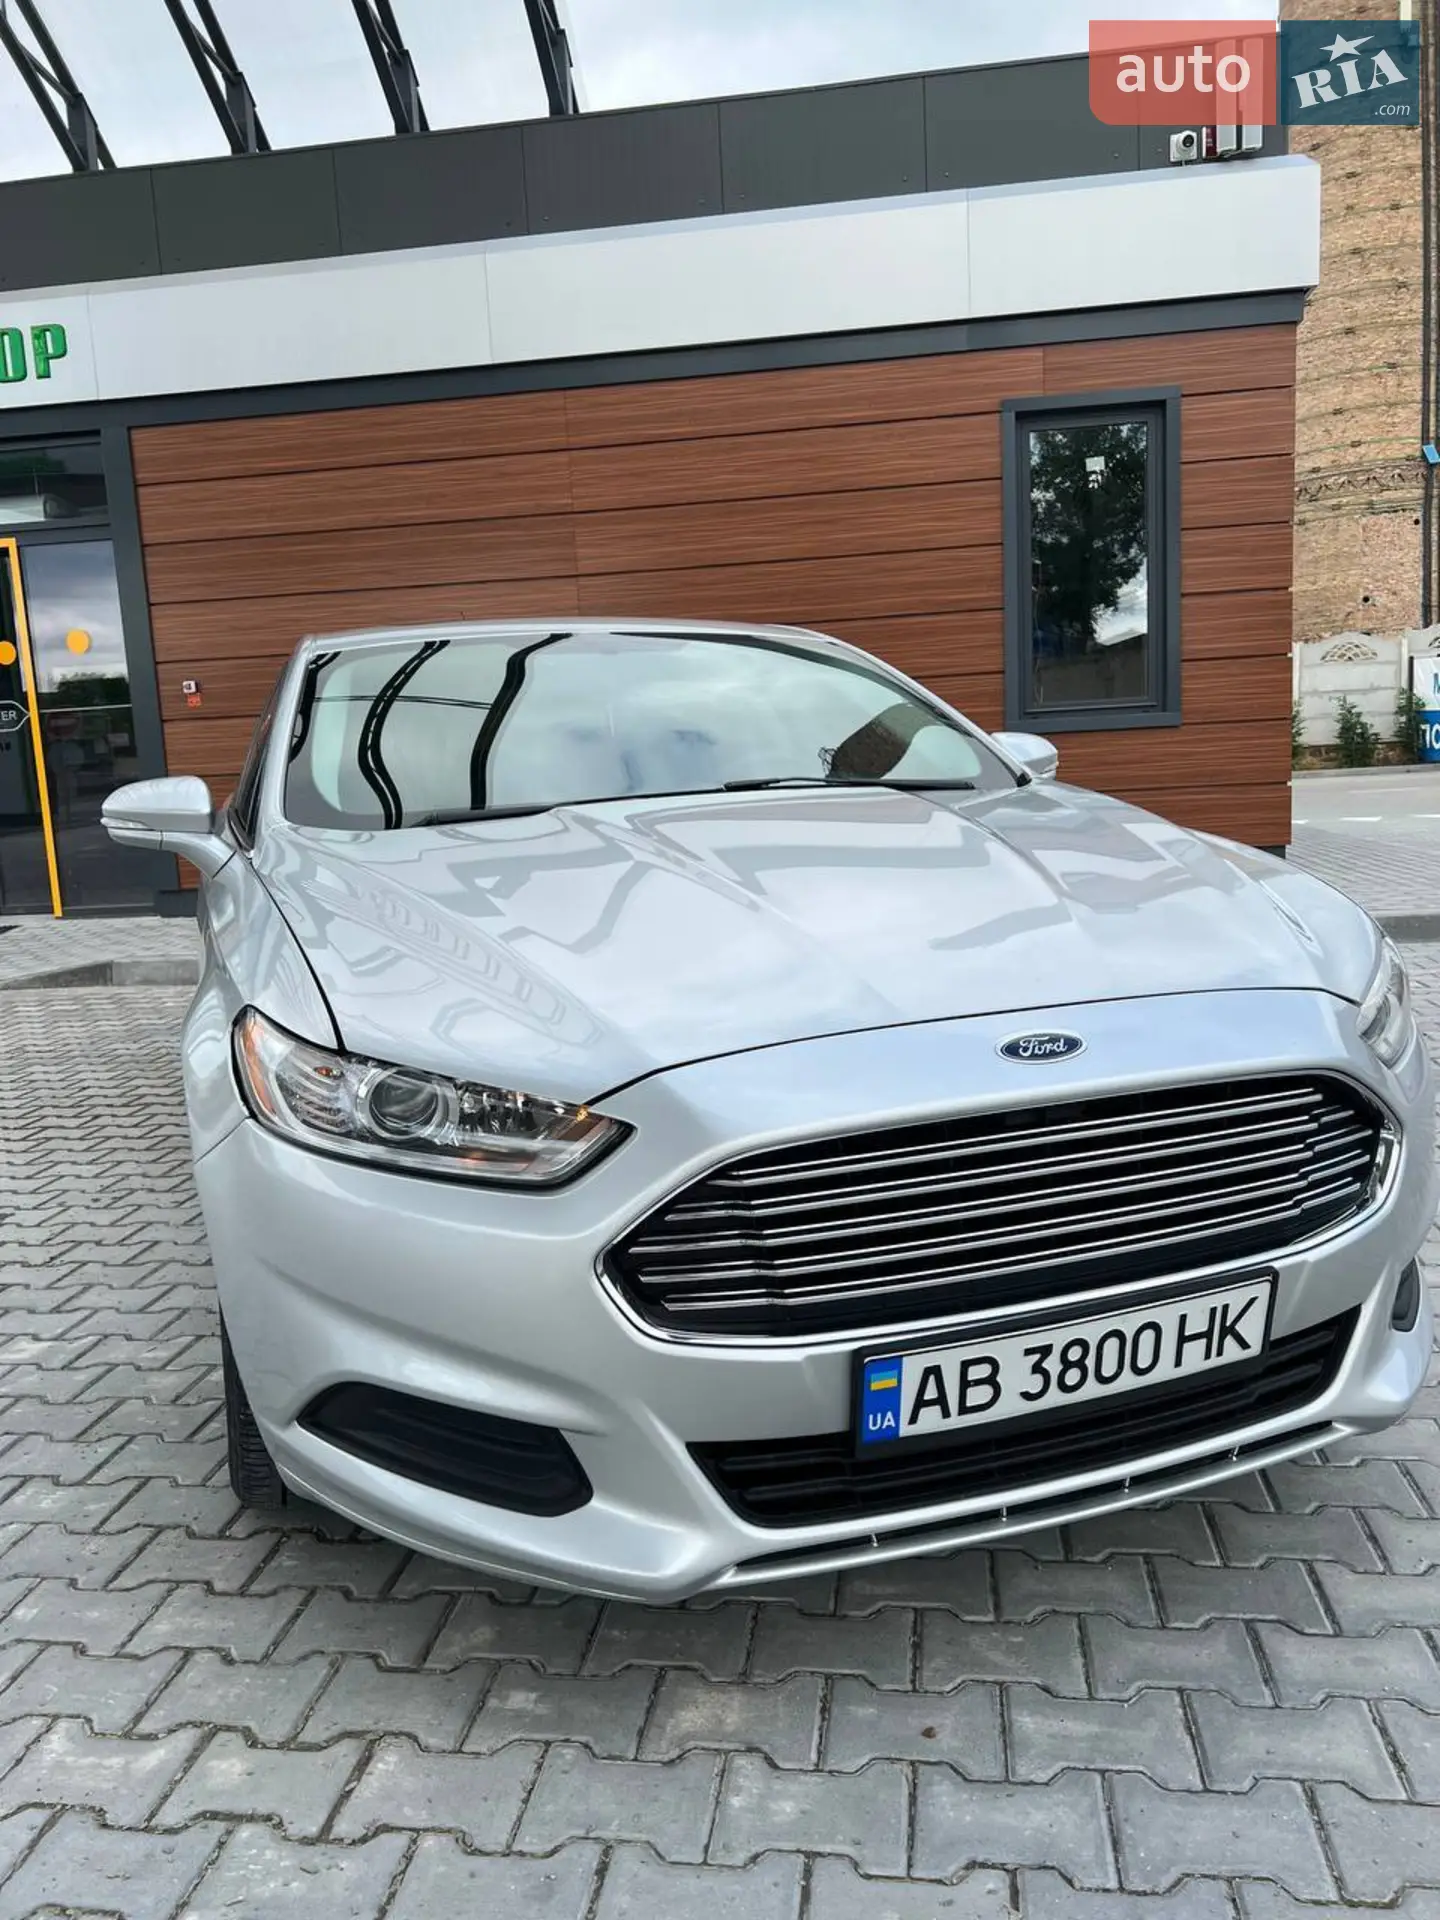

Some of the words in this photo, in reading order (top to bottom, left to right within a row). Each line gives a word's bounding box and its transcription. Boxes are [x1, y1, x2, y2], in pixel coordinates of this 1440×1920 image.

[1019, 1036, 1068, 1057] Ford
[908, 1355, 1002, 1426] AB
[1019, 1320, 1163, 1402] 3800
[1174, 1296, 1259, 1369] HK
[868, 1412, 896, 1432] UA
